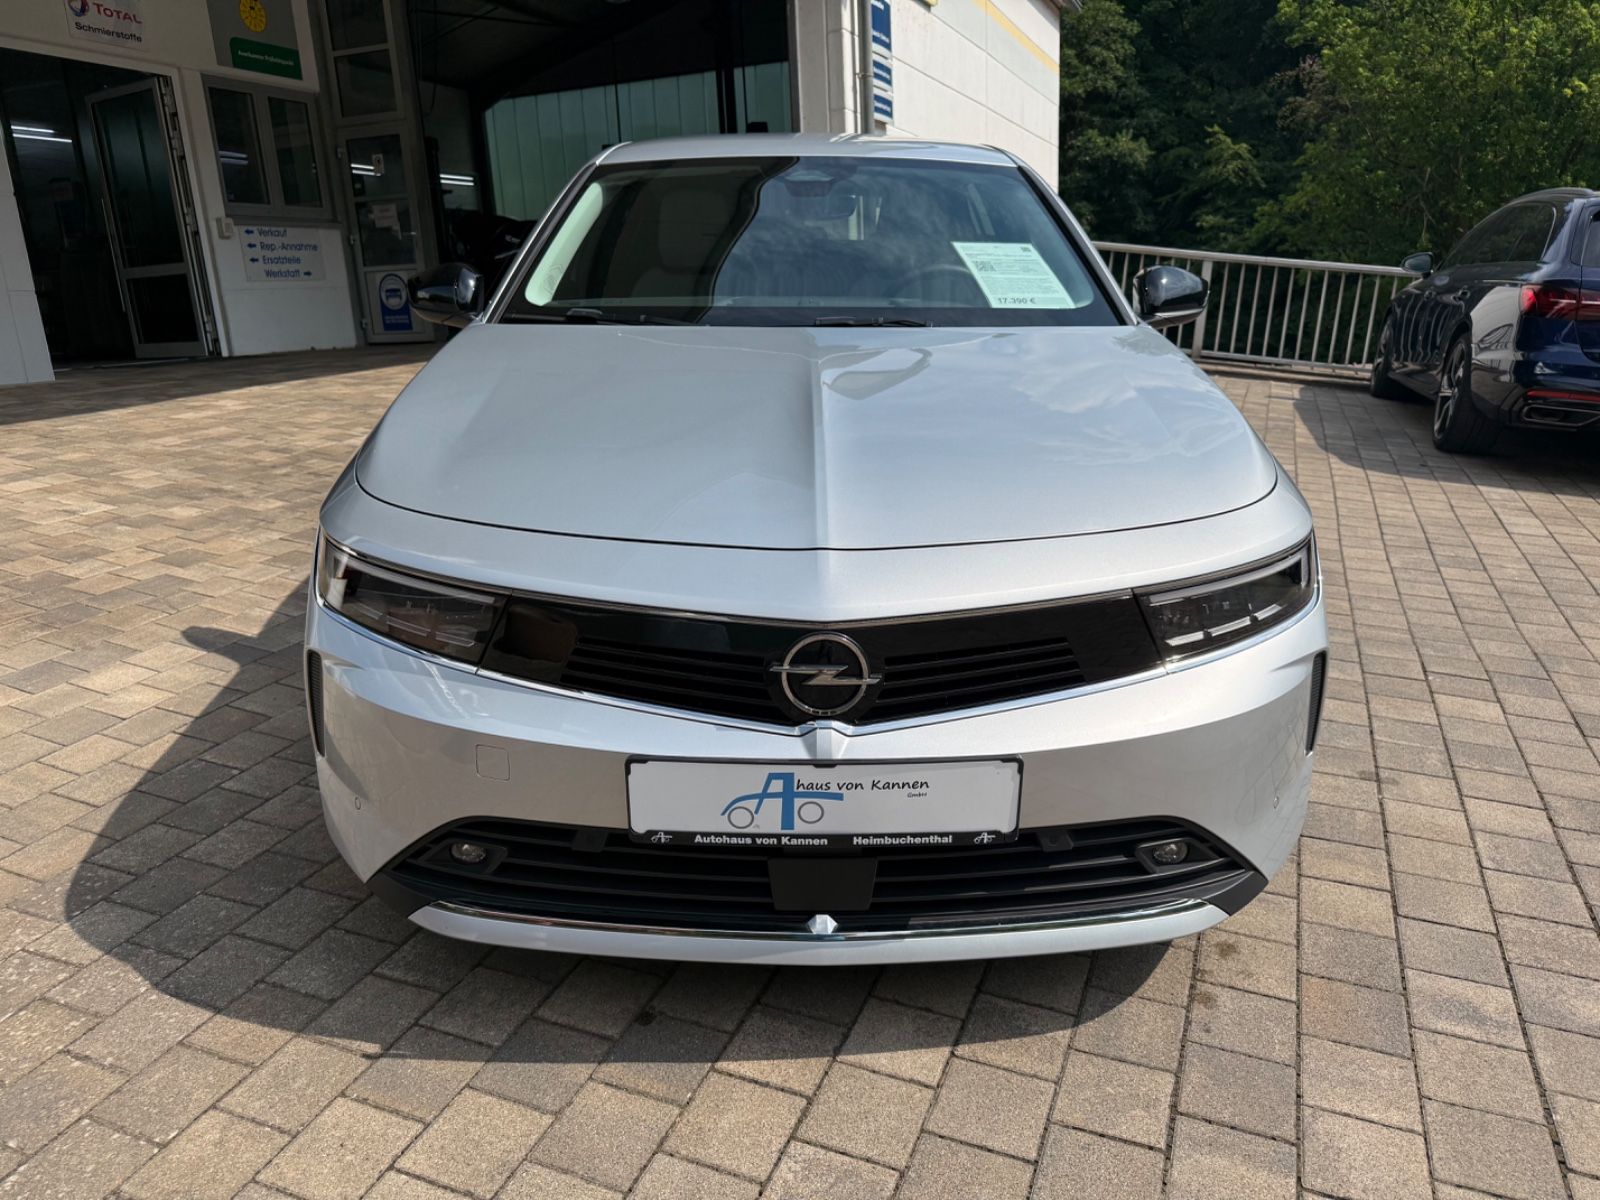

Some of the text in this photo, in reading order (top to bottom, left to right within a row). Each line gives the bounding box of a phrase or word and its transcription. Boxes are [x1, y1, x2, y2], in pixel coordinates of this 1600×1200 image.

[93, 2, 143, 24] TOTAL
[75, 22, 142, 43] Schmierstoffe
[257, 228, 287, 237] Verkauf
[260, 242, 318, 252] Rep.-Annahme
[262, 255, 301, 264] Ersatzteile
[264, 269, 301, 278] Werkstatt
[837, 781, 865, 791] von
[871, 779, 930, 790] Kannen
[694, 834, 953, 846] Autohaus von Kannen Heimbuchenthal
